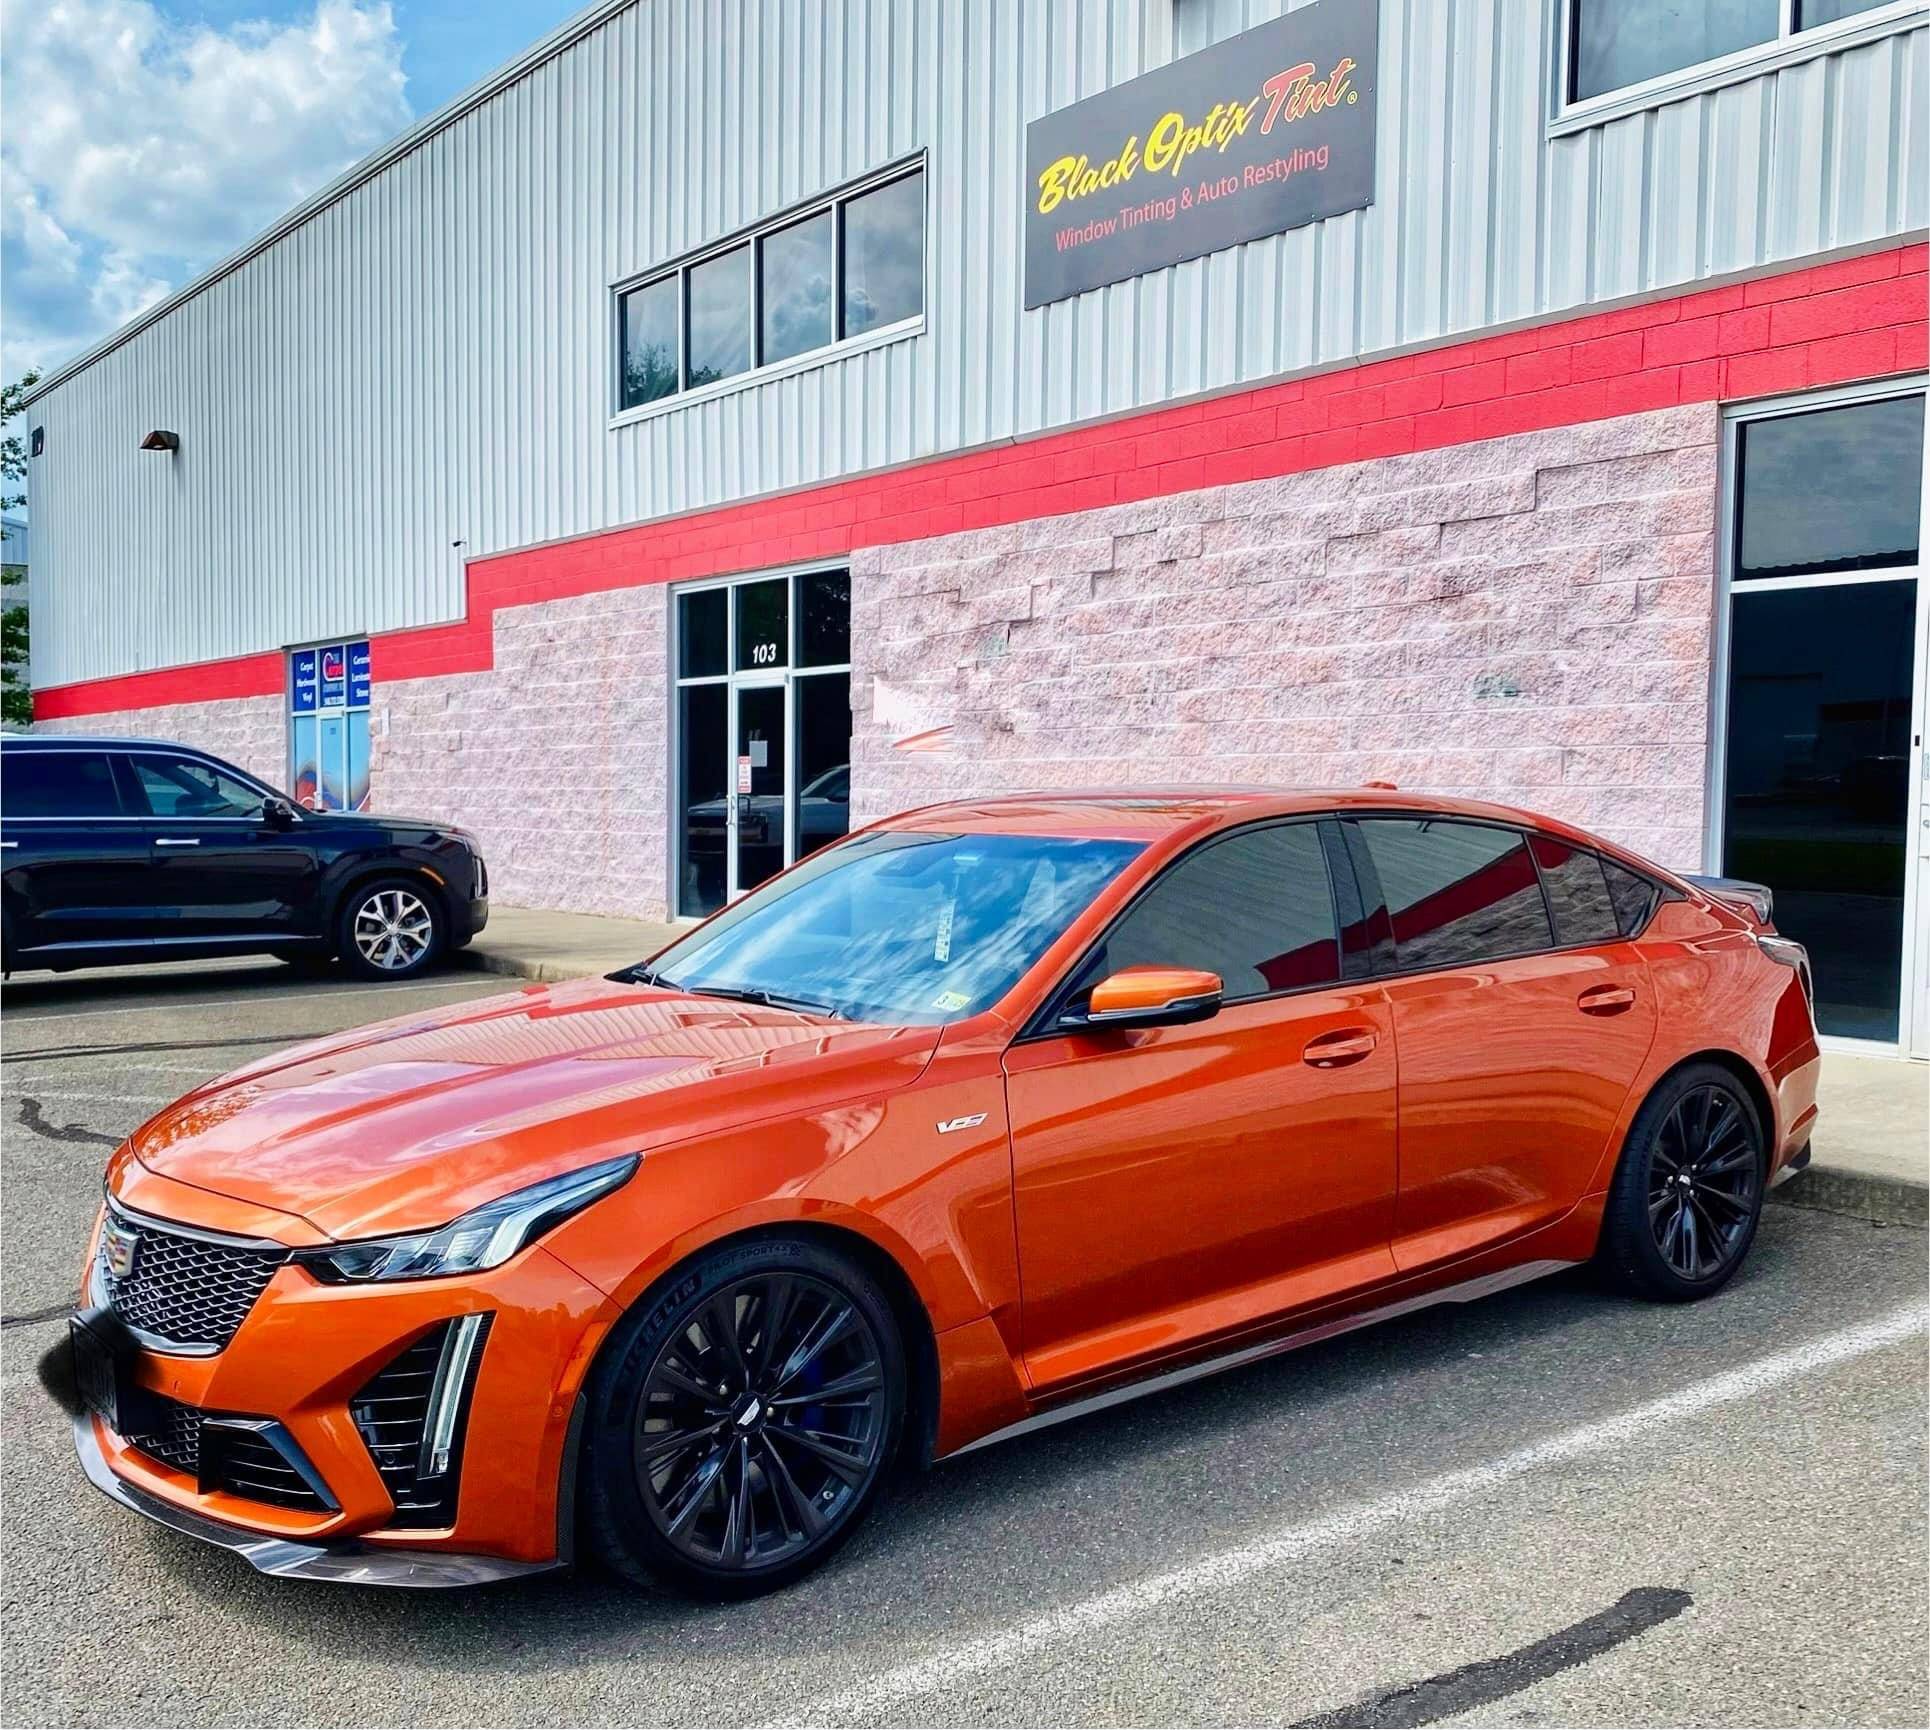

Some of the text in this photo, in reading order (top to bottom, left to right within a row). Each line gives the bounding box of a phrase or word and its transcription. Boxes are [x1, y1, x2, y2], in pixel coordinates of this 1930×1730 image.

[1038, 136, 1140, 214] Black
[1143, 97, 1260, 177] Optix
[1055, 145, 1329, 252] Window Tinting & Auto Restyling
[752, 643, 777, 664] 103
